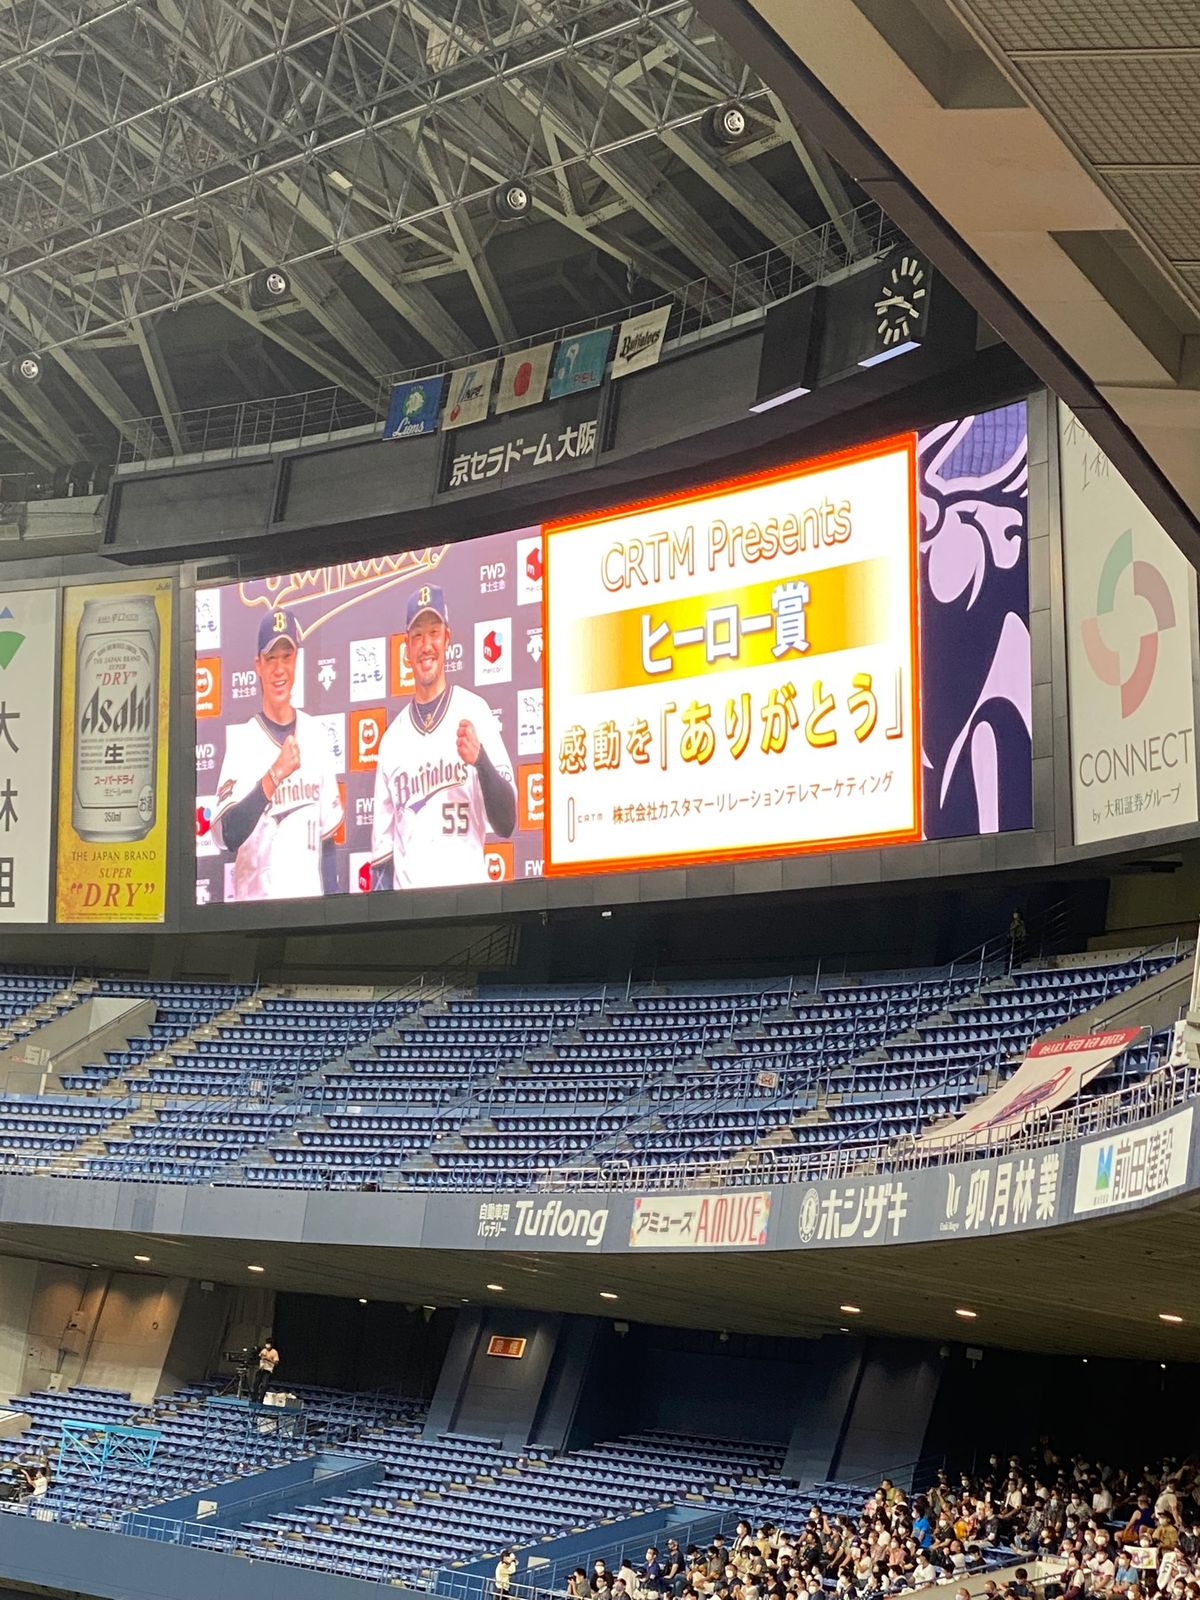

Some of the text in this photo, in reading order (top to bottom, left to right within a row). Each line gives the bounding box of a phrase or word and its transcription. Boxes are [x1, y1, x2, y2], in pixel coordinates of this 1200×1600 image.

[392, 417, 424, 437] Lions
[450, 420, 597, 487] 京セラドーム 大阪
[601, 496, 852, 592] CRTM Presents
[480, 563, 505, 581] FWD
[641, 580, 810, 674] ヒーロー賞
[445, 644, 463, 660] WD
[232, 671, 257, 687] FWD
[81, 684, 151, 734] Asahi
[559, 666, 903, 774] 感動を「ありがとう」
[104, 743, 124, 764] 生
[196, 743, 215, 758] WD
[1080, 728, 1192, 787] CONNECT
[442, 803, 469, 834] 55
[612, 771, 894, 825] 株式会社カスタマーリレーションテレマーケティング
[1092, 783, 1181, 823] by 大和証券グループ
[72, 850, 156, 861] THE JAPAN BRAND
[307, 820, 316, 851] 11
[99, 867, 132, 878] SUPER
[1112, 1127, 1173, 1201] 前田建設
[817, 1182, 908, 1240] ホシザキ
[964, 1153, 1059, 1230] 卯月林業
[514, 1200, 608, 1247] Tuflong
[636, 1196, 763, 1243] アミューズ AMUSE
